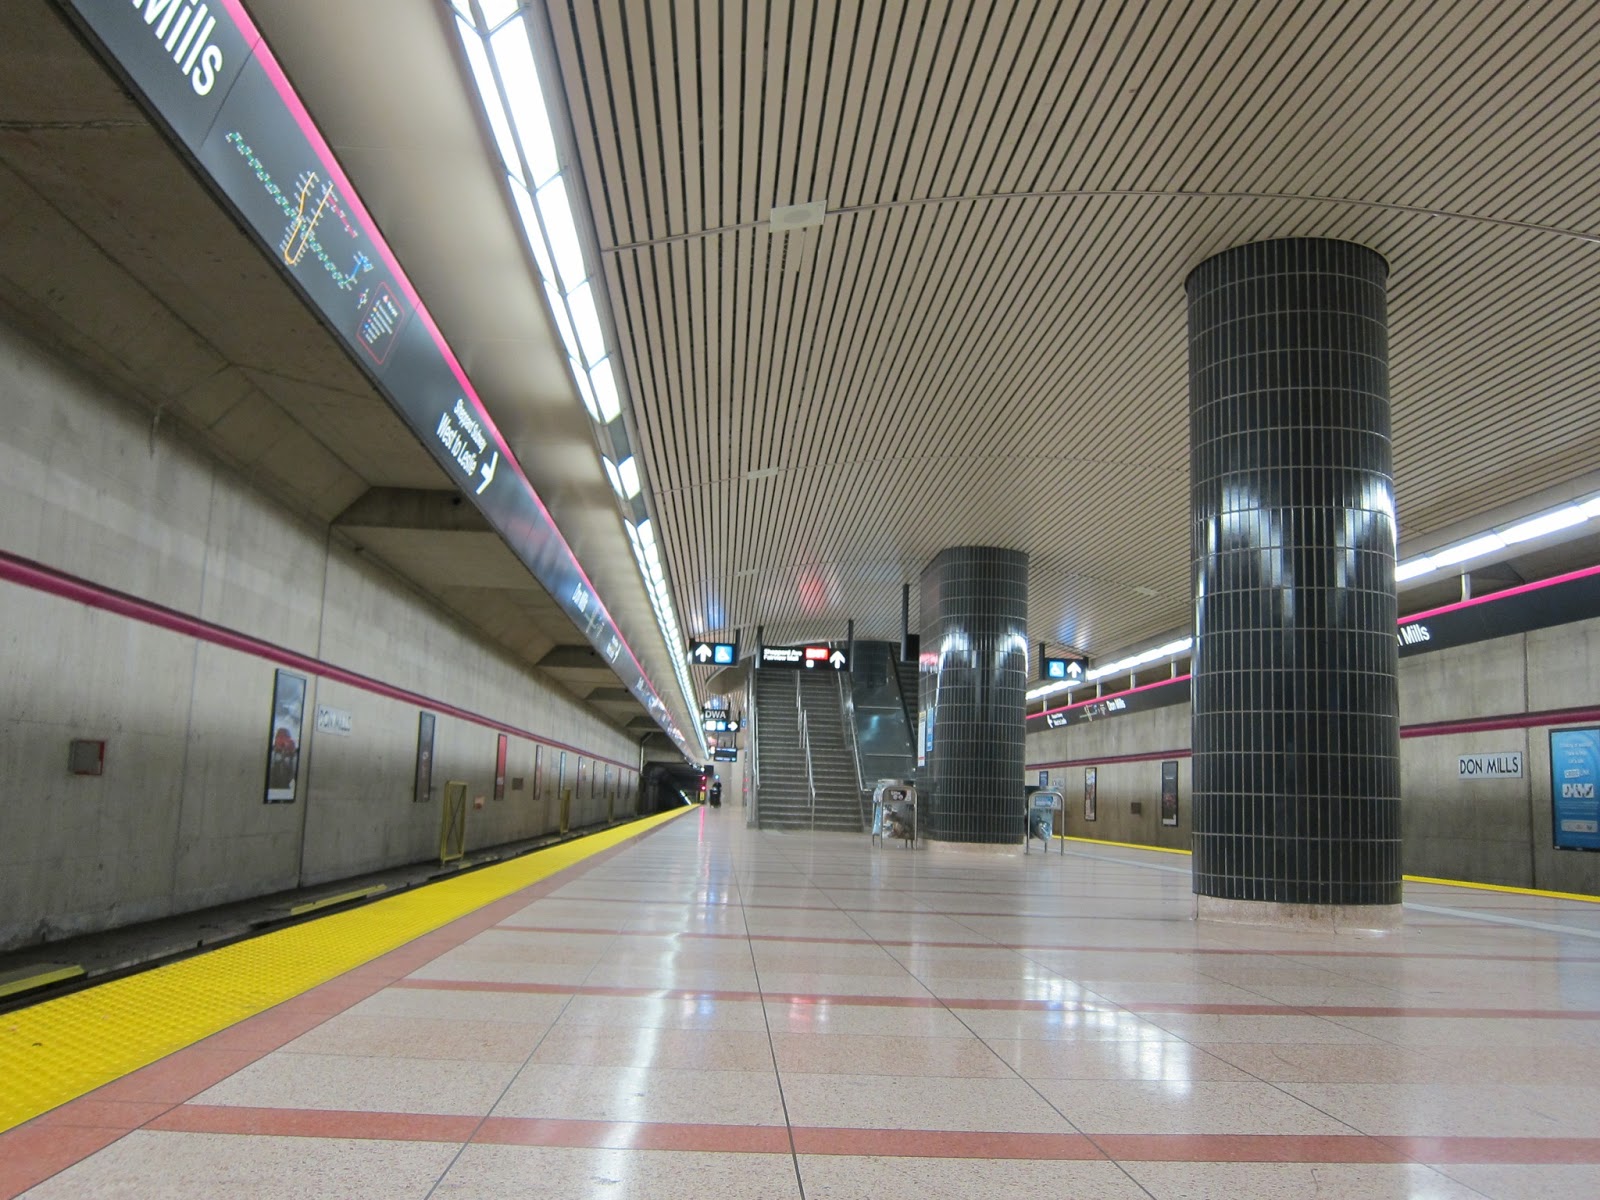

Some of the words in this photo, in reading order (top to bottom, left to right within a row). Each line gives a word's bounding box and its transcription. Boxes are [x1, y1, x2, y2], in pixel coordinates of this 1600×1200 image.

[436, 412, 458, 450] West
[450, 434, 462, 457] to
[457, 441, 478, 476] Leslie
[1400, 623, 1430, 645] Mills
[704, 710, 727, 719] DWA
[1460, 758, 1483, 775] DON
[1486, 756, 1519, 774] MILLS
